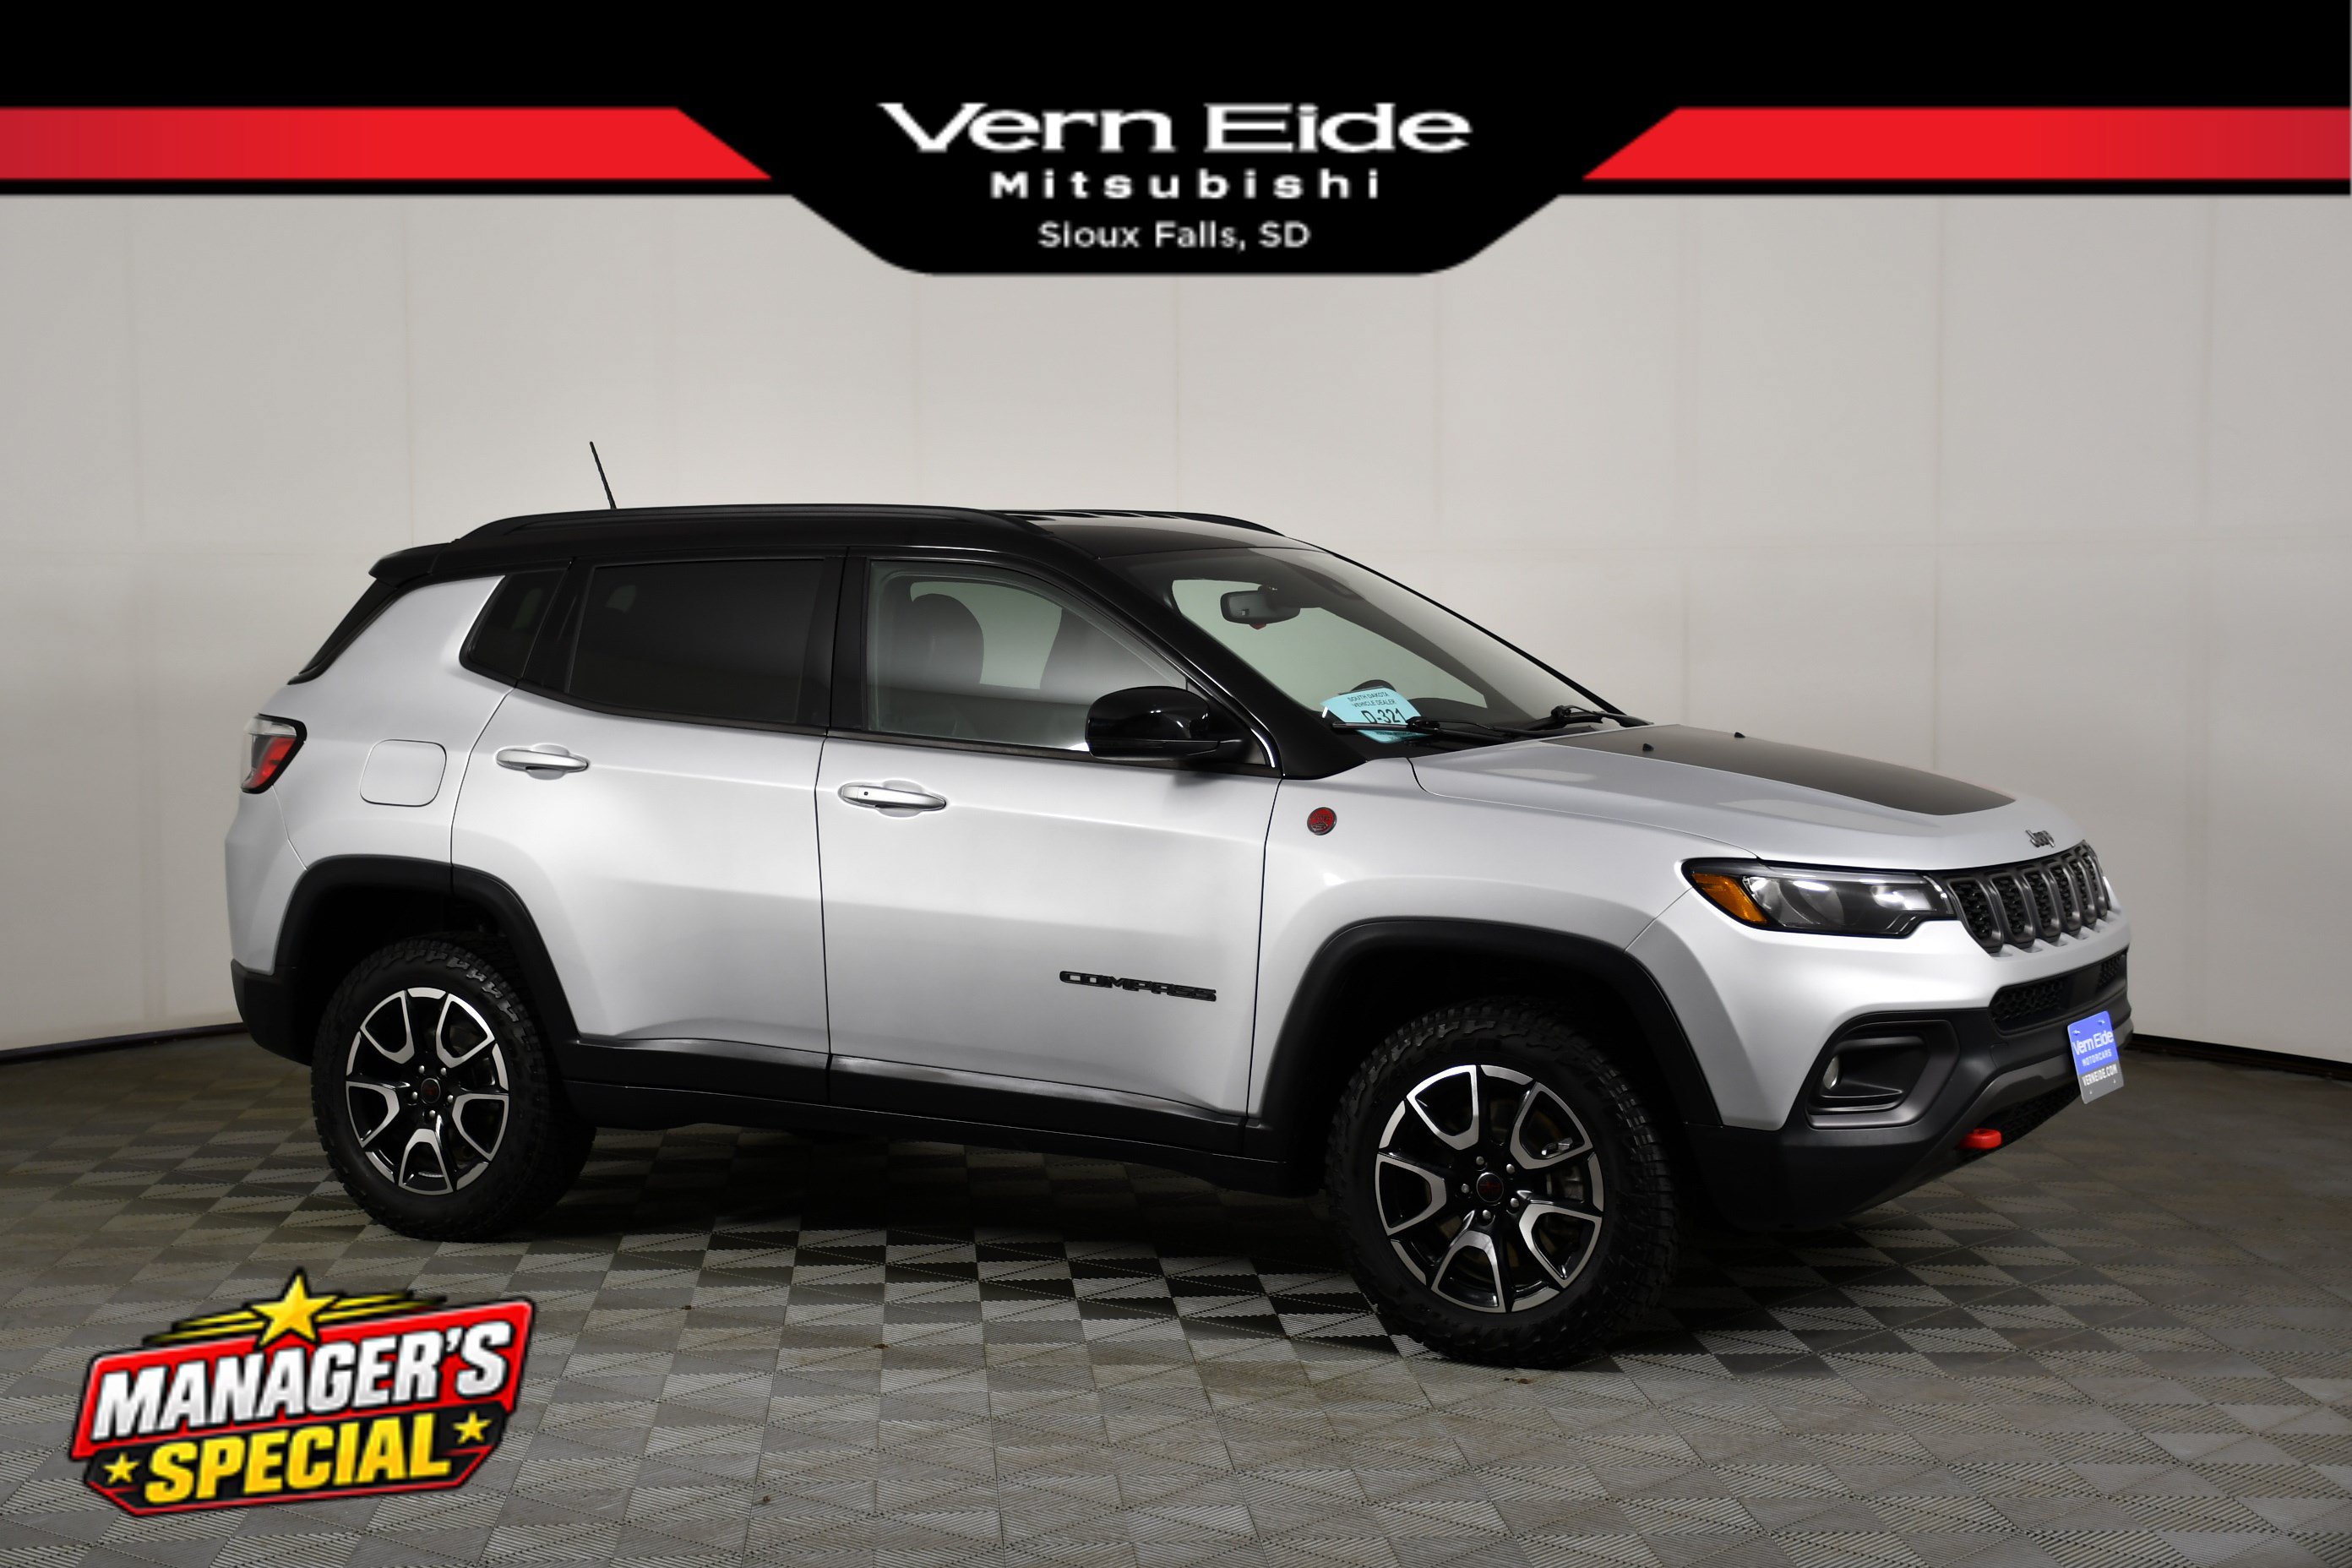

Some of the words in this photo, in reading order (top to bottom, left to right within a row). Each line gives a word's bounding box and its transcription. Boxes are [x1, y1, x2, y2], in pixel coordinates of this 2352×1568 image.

[1360, 708, 1407, 724] D-321
[1059, 971, 1217, 1002] COMPASS
[2072, 1037, 2094, 1055] Vern
[2093, 1030, 2114, 1048] Eide
[2082, 1064, 2118, 1086] VERNEIDE.COM
